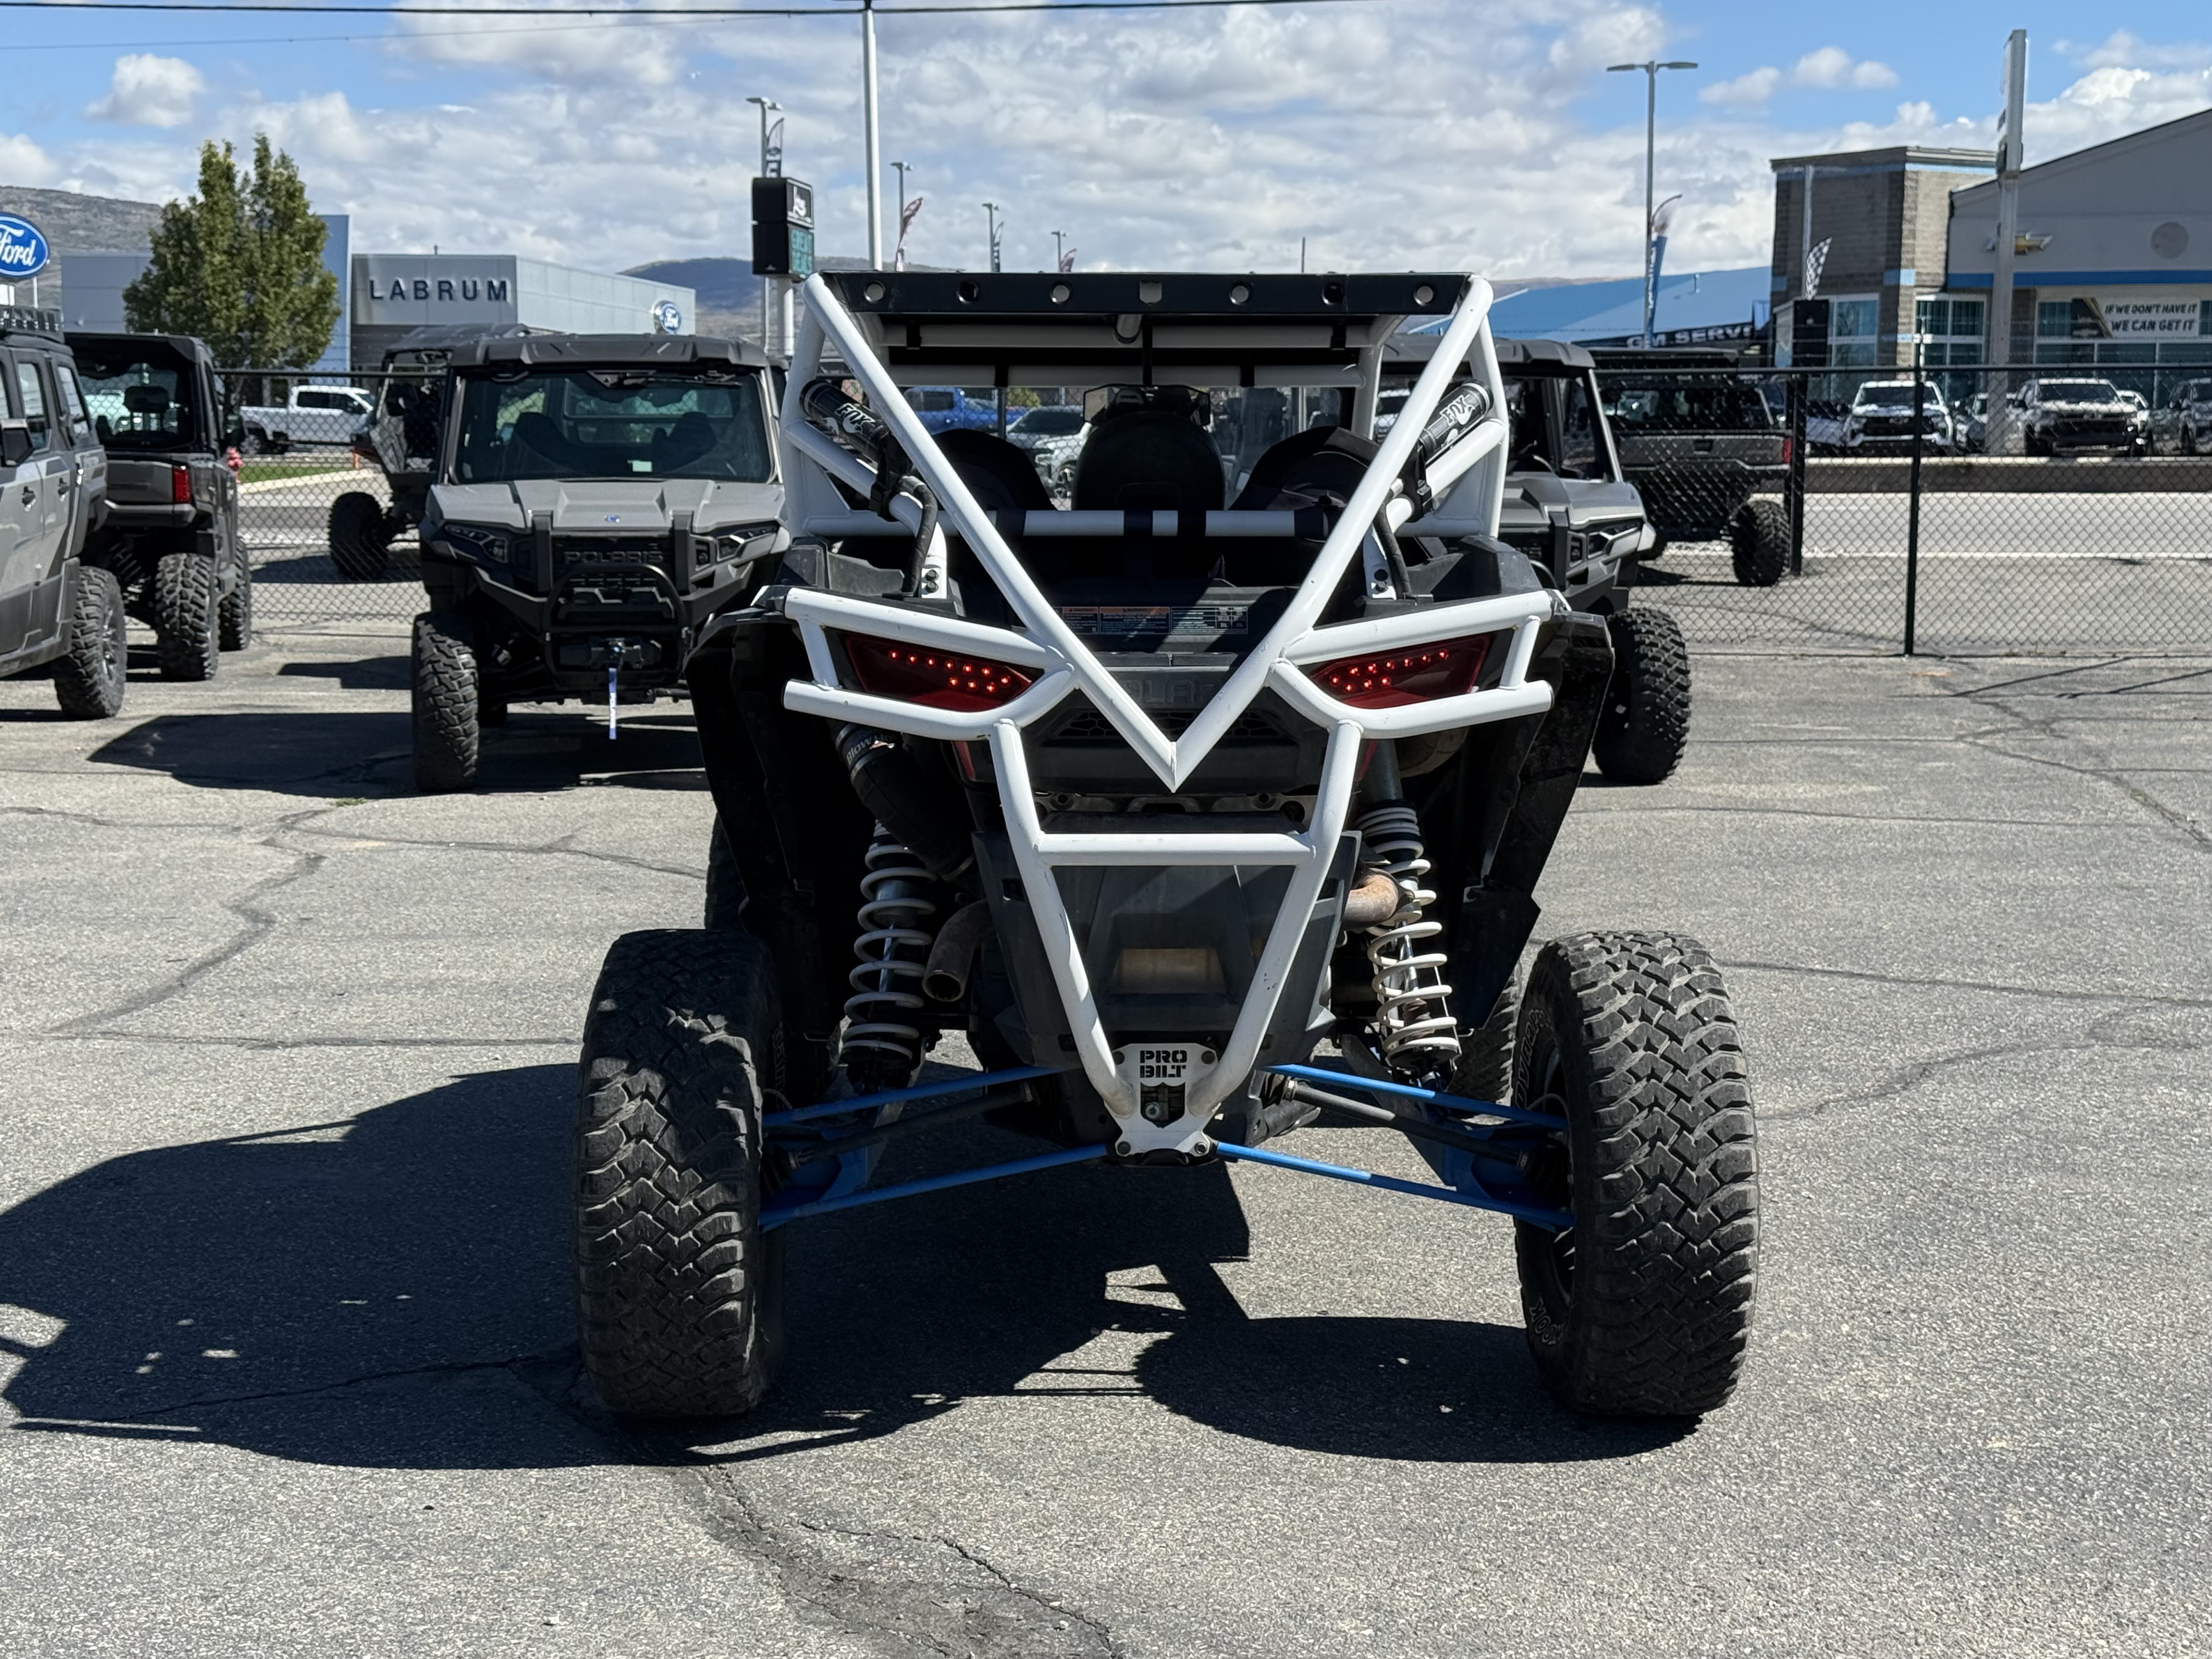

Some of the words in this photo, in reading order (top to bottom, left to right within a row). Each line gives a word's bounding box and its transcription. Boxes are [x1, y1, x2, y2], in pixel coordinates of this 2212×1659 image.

[0, 224, 37, 267] Ford
[369, 280, 507, 302] LABRUM
[2104, 304, 2115, 314] IF
[2116, 304, 2131, 314] WE
[2131, 304, 2162, 314] DON'T
[2162, 304, 2187, 314] HAVE
[2187, 303, 2198, 314] IT
[2112, 319, 2129, 332] WE
[2131, 319, 2156, 331] CAN
[2159, 319, 2181, 331] GET
[2182, 319, 2195, 331] IT
[1626, 334, 1666, 349] GM
[834, 403, 876, 426] FOX
[1440, 394, 1471, 426] FOX
[564, 550, 663, 563] POLARIS
[846, 736, 873, 766] Blow
[1140, 1049, 1187, 1063] PRO
[1140, 1065, 1186, 1079] BILT
